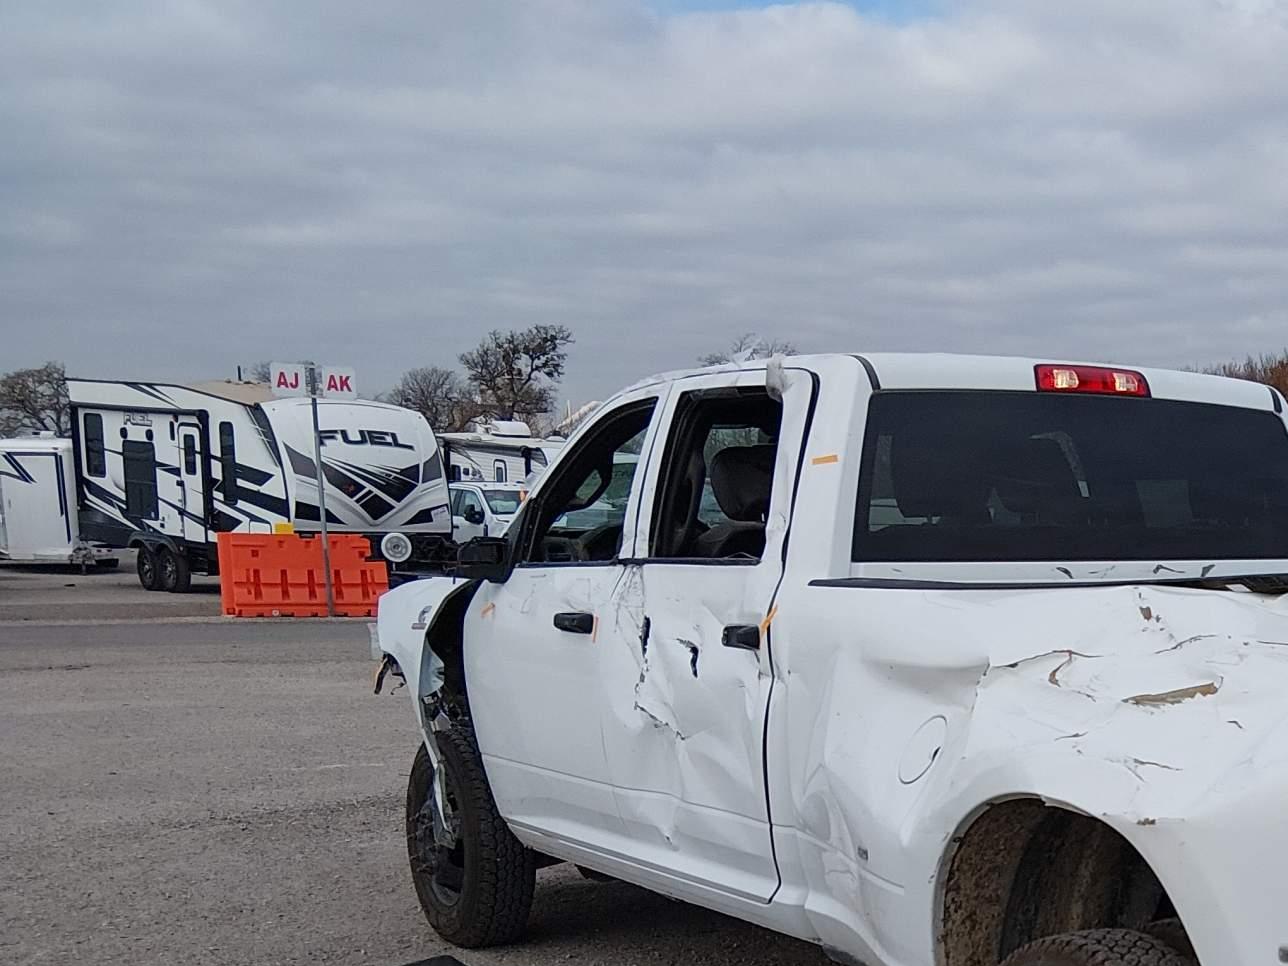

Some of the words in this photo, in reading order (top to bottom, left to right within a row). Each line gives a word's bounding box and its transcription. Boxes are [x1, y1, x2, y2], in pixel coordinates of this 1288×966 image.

[276, 371, 299, 389] AJ
[326, 374, 352, 392] AK
[318, 429, 416, 451] FUEL
